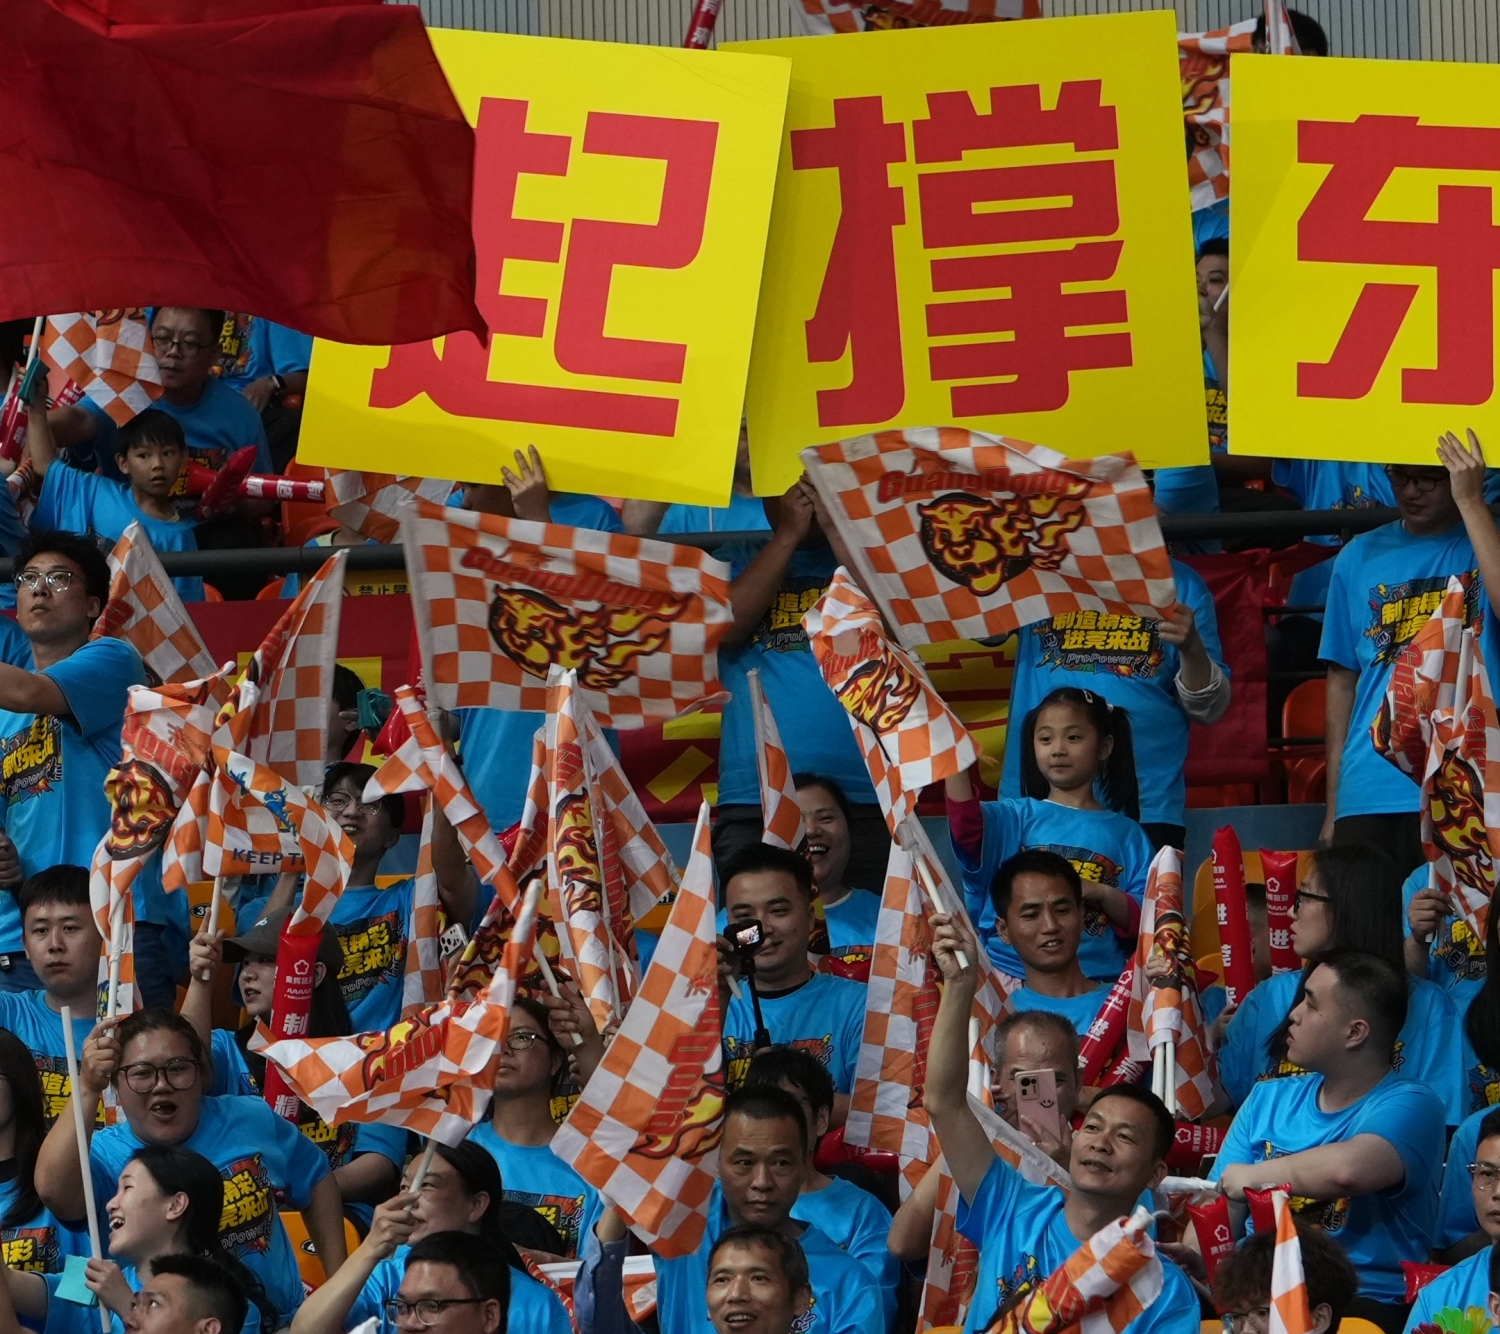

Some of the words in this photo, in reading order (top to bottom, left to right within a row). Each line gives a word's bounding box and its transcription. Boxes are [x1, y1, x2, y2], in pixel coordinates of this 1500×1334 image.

[1052, 610, 1142, 631] 制造精彩
[1061, 629, 1150, 651] 进莞来战
[233, 848, 283, 865] KEEP
